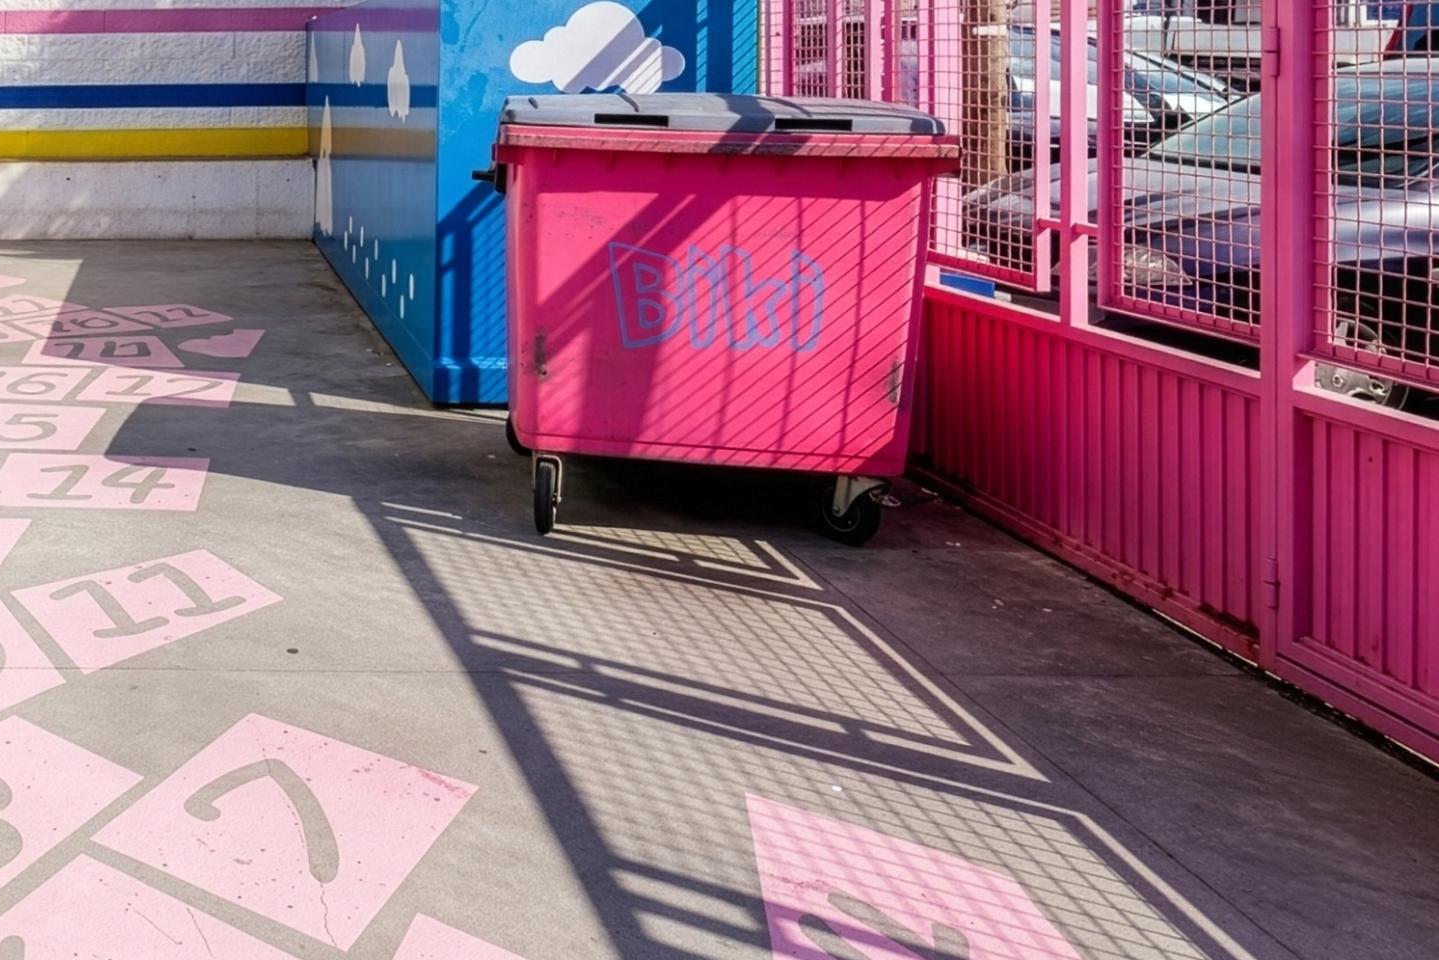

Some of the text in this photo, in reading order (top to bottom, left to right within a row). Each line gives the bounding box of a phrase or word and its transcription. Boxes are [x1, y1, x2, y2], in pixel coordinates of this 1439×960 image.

[26, 462, 176, 505] 14
[49, 561, 248, 640] 11
[183, 758, 340, 886] 7
